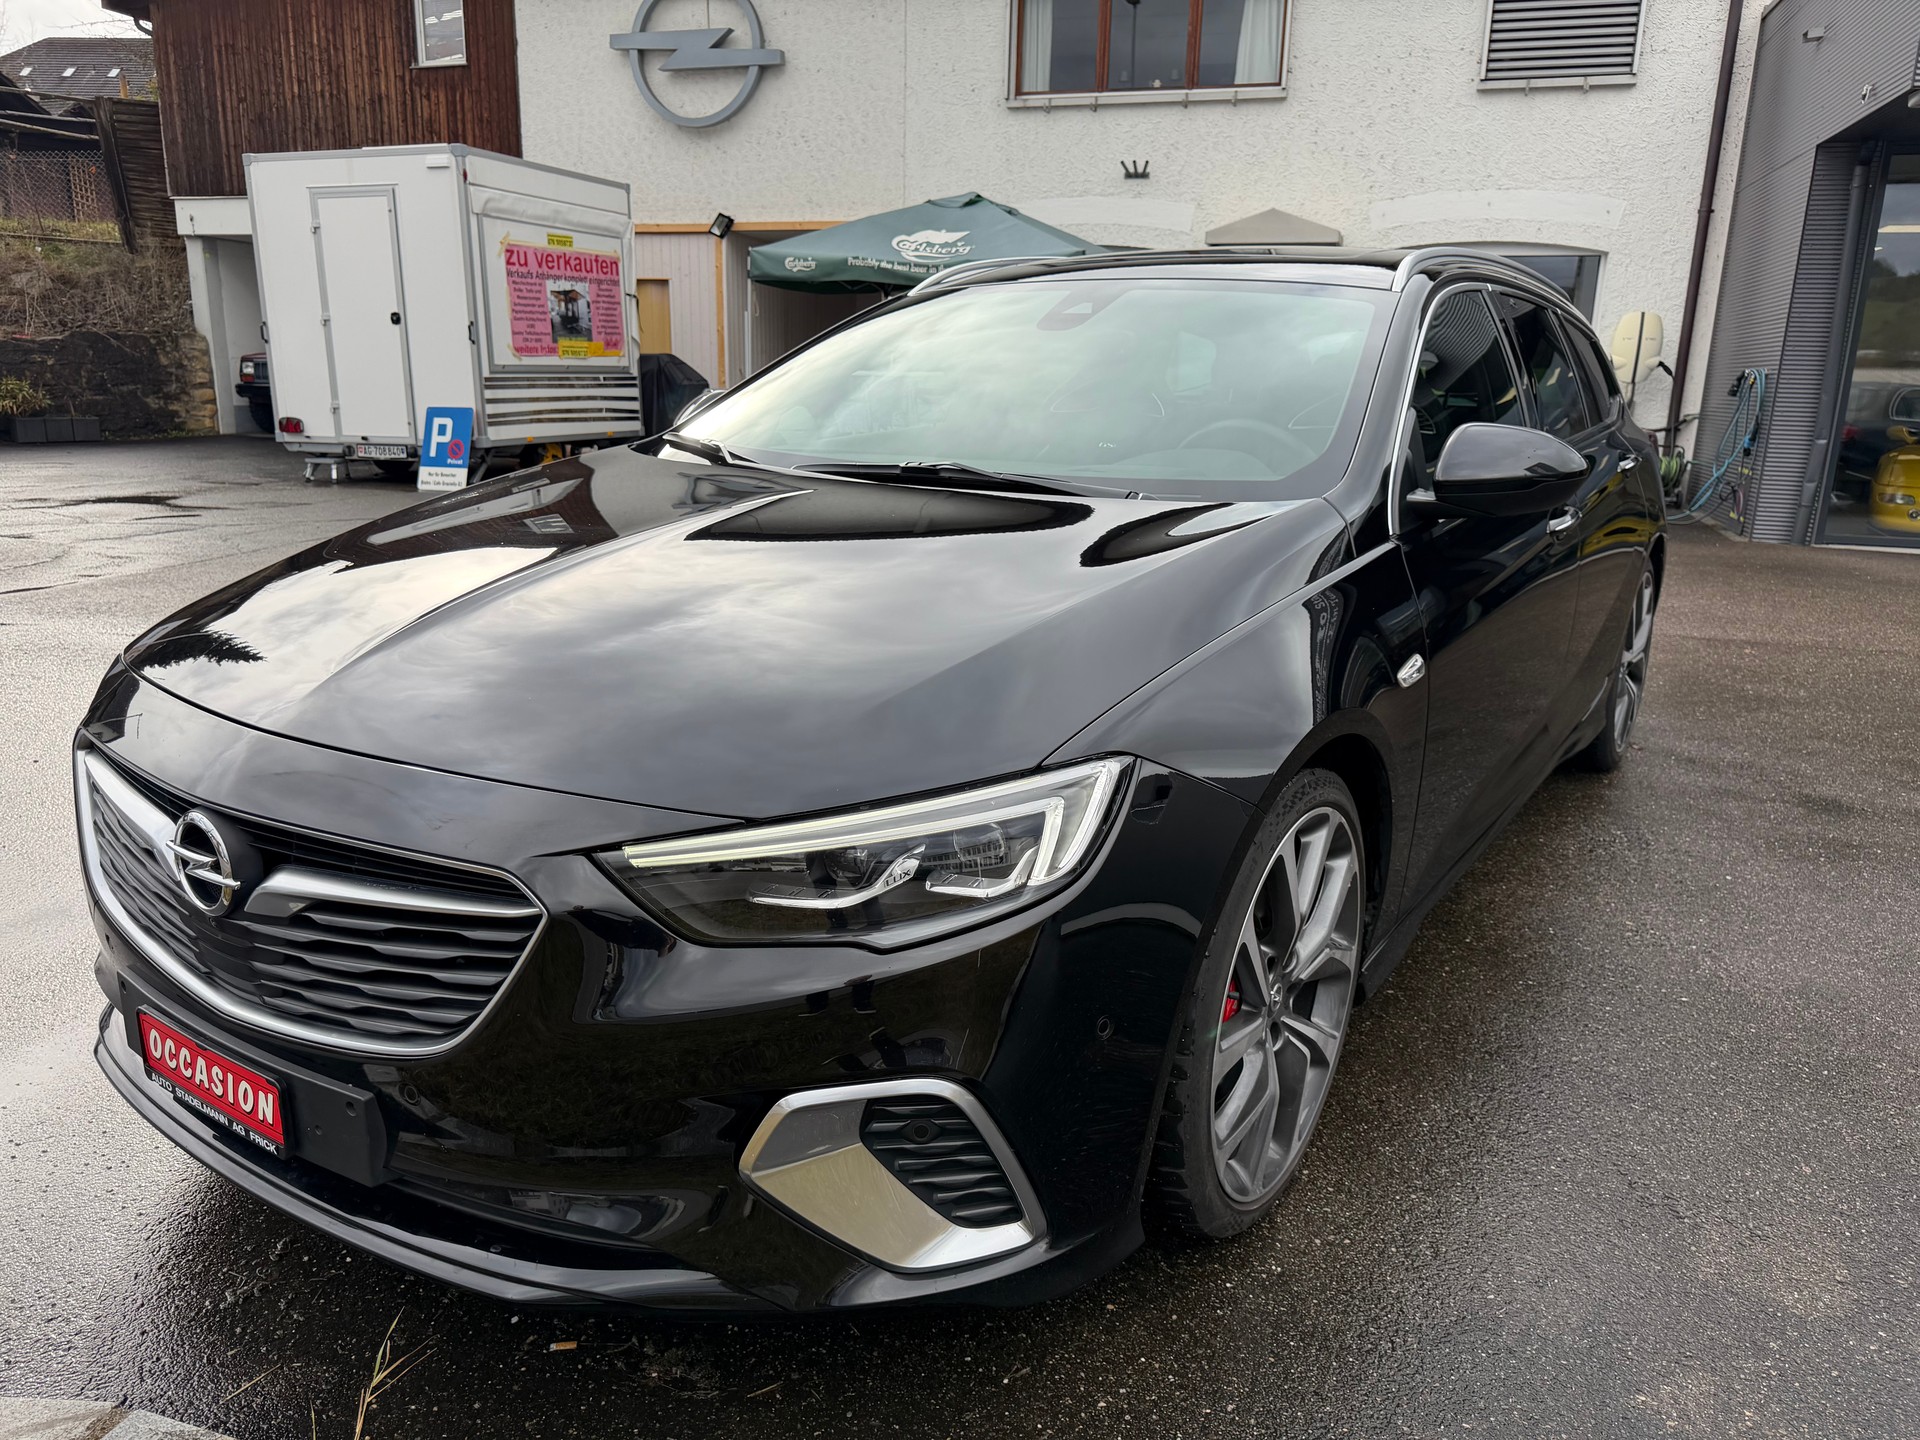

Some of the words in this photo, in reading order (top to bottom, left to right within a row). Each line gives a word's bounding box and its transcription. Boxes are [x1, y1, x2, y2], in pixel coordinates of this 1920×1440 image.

[505, 248, 528, 268] zu
[534, 252, 619, 276] verkaufen
[891, 231, 972, 262] Carlsberg
[507, 267, 534, 280] Verkaufs
[847, 257, 879, 270] Probably
[880, 260, 893, 270] the
[893, 262, 910, 272] best
[910, 263, 928, 273] beer
[929, 264, 938, 273] in
[429, 417, 453, 457] P
[149, 1028, 275, 1127] OCCASION
[151, 1072, 173, 1092] AUTO
[175, 1085, 229, 1126] STADELMANN
[232, 1122, 246, 1137] AG
[249, 1131, 278, 1155] FRICK
